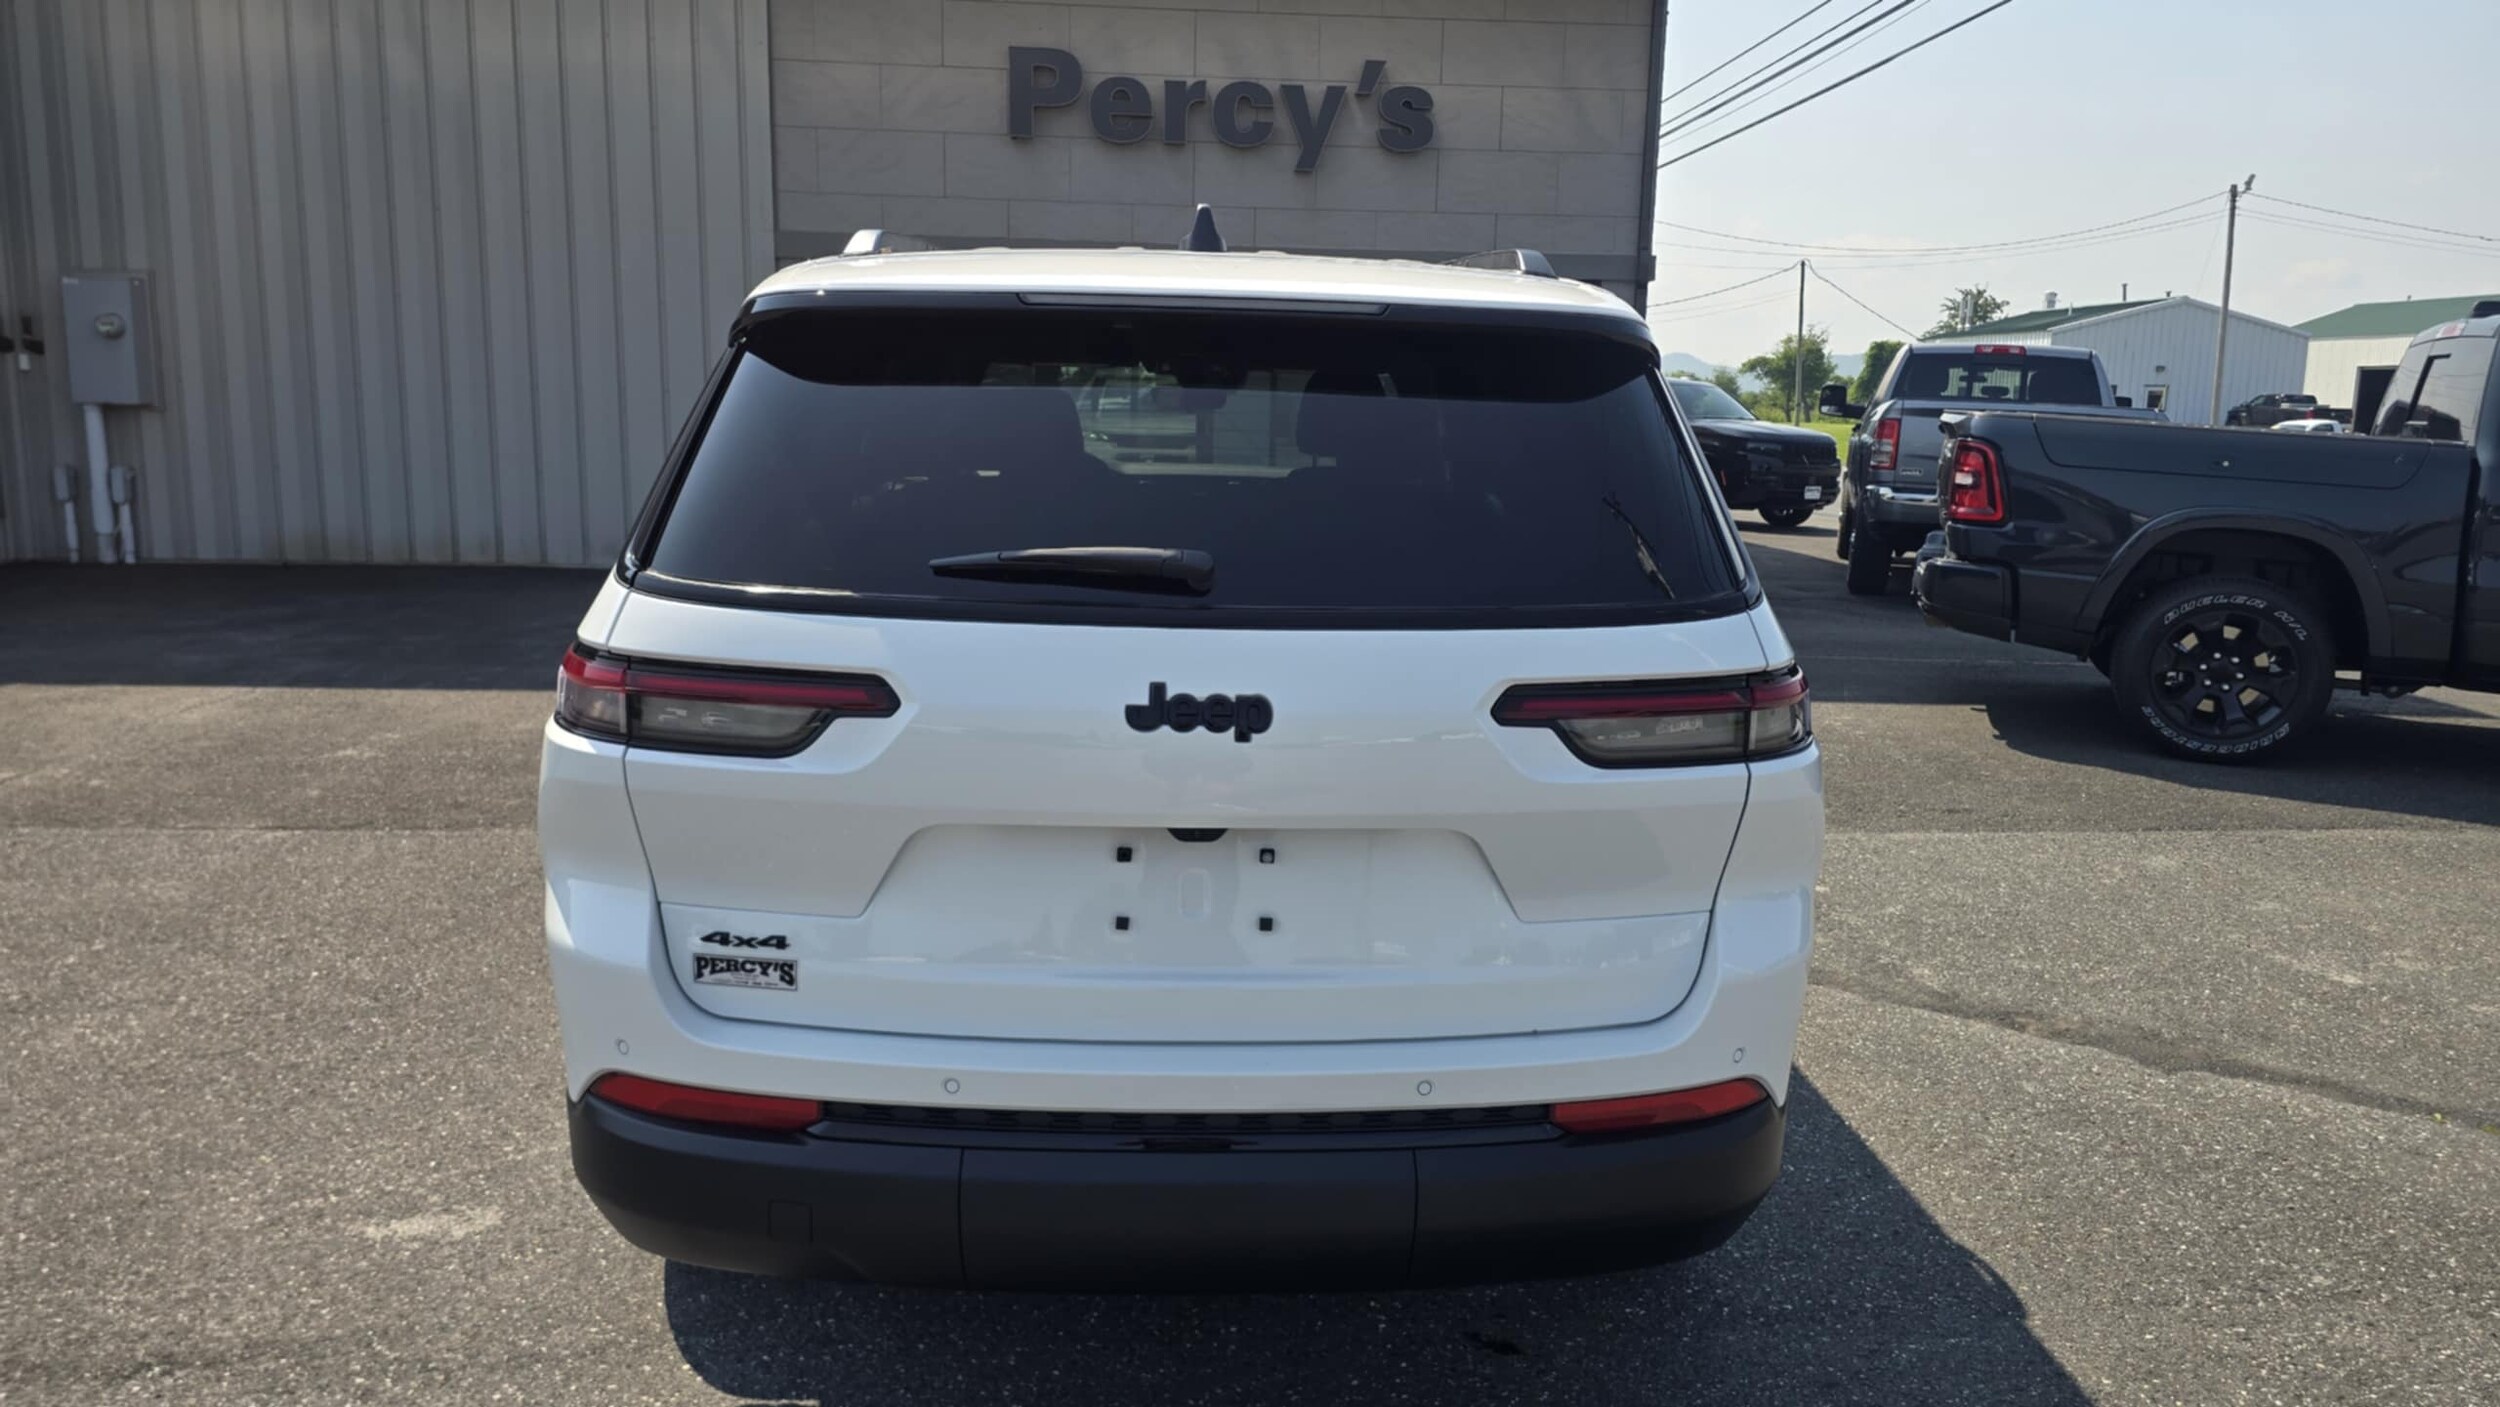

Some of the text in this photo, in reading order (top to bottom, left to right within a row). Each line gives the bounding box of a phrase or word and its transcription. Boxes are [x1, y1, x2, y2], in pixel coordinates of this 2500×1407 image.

[1008, 46, 1436, 173] Percy's
[1125, 681, 1273, 743] Jeep
[700, 931, 790, 950] 4x4
[696, 956, 795, 986] PERCY'S
